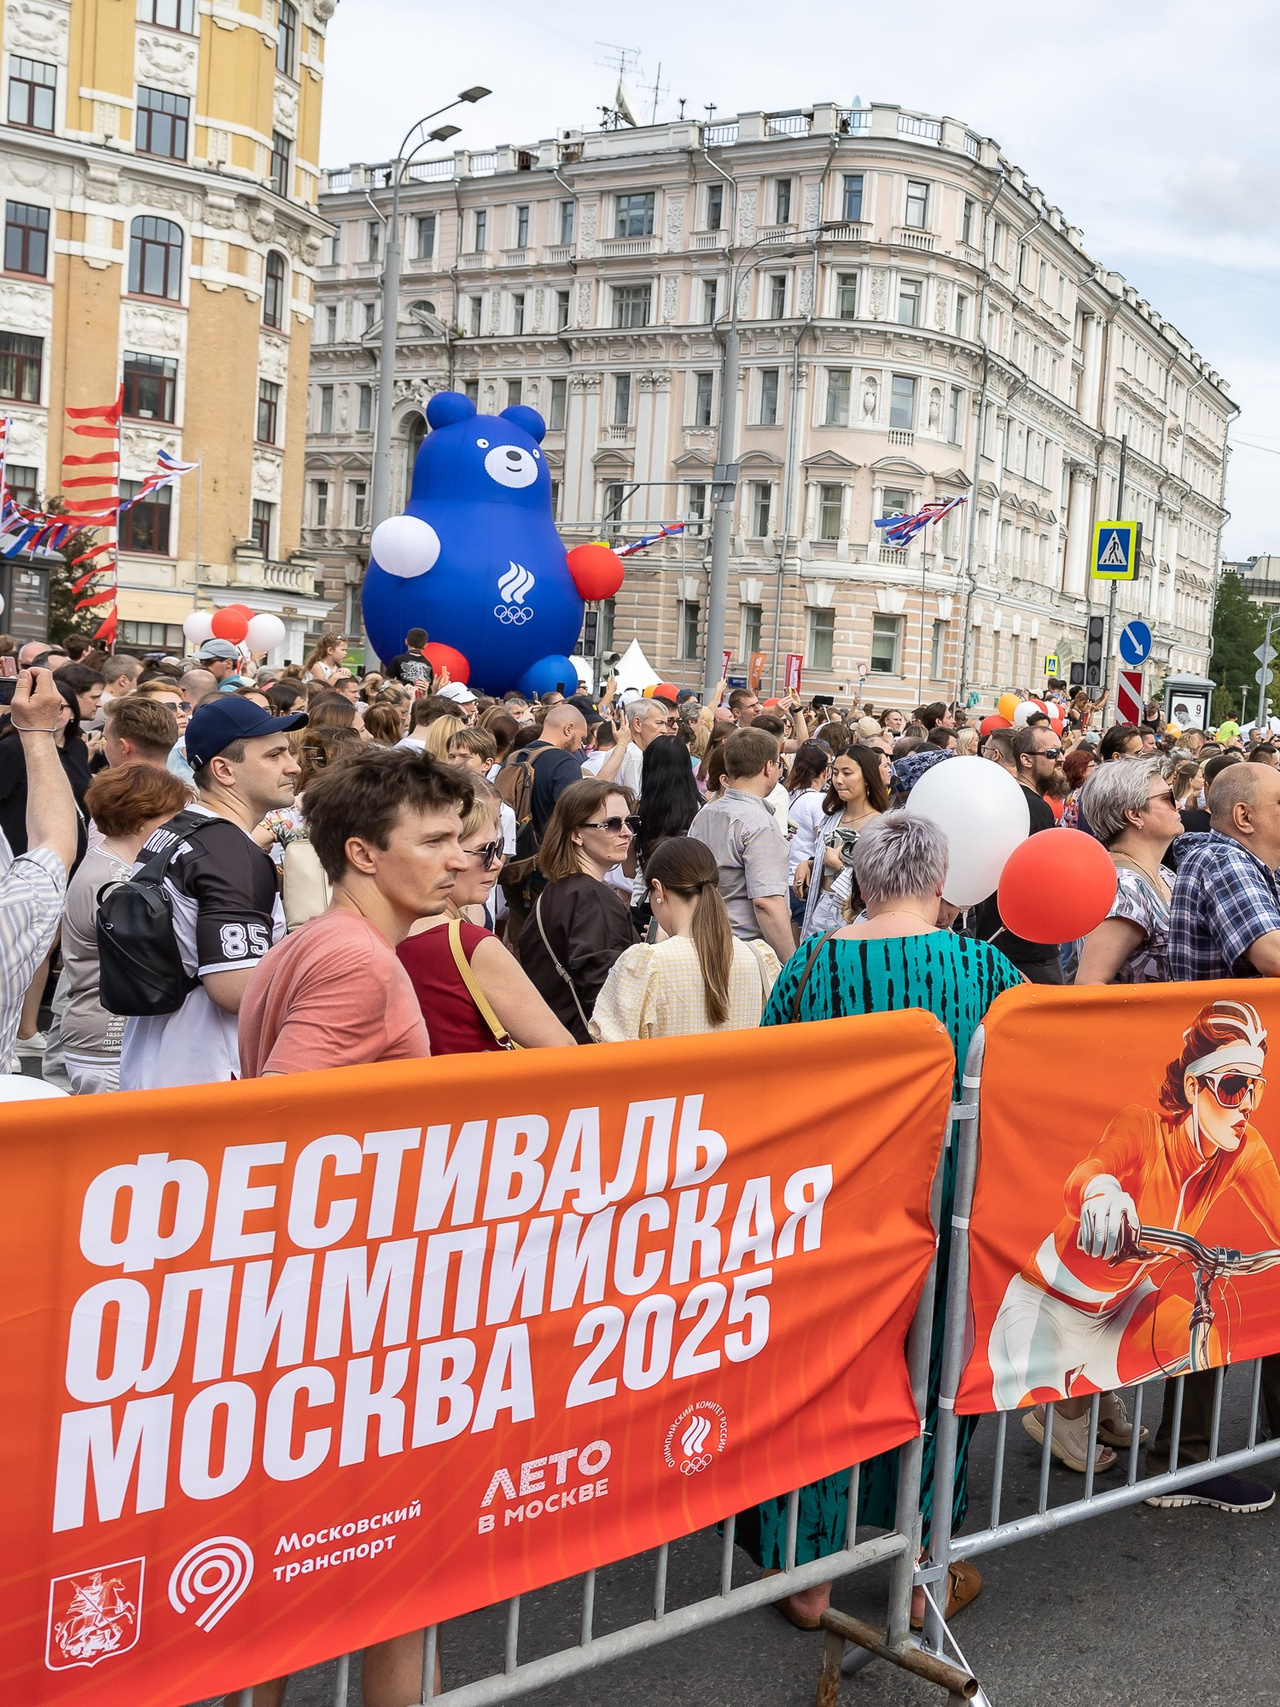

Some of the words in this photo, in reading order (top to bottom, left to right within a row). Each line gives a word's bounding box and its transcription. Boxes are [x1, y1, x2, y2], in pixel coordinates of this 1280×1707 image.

[220, 923, 269, 959] 85
[79, 1093, 729, 1274] ФЕСТИВАЛЬ
[64, 1164, 834, 1403] ОЛИМПИЙСКАЯ
[52, 1323, 535, 1533] МОСКВА
[564, 1266, 773, 1410] 2025
[695, 1400, 725, 1417] КОМИТЕТ
[716, 1416, 728, 1453] РОССИИ
[480, 1439, 612, 1508] ЛЕТО
[274, 1499, 422, 1556] Московский
[477, 1513, 496, 1535] В
[504, 1477, 609, 1527] МОСКВЕ
[273, 1535, 397, 1583] транспорт
